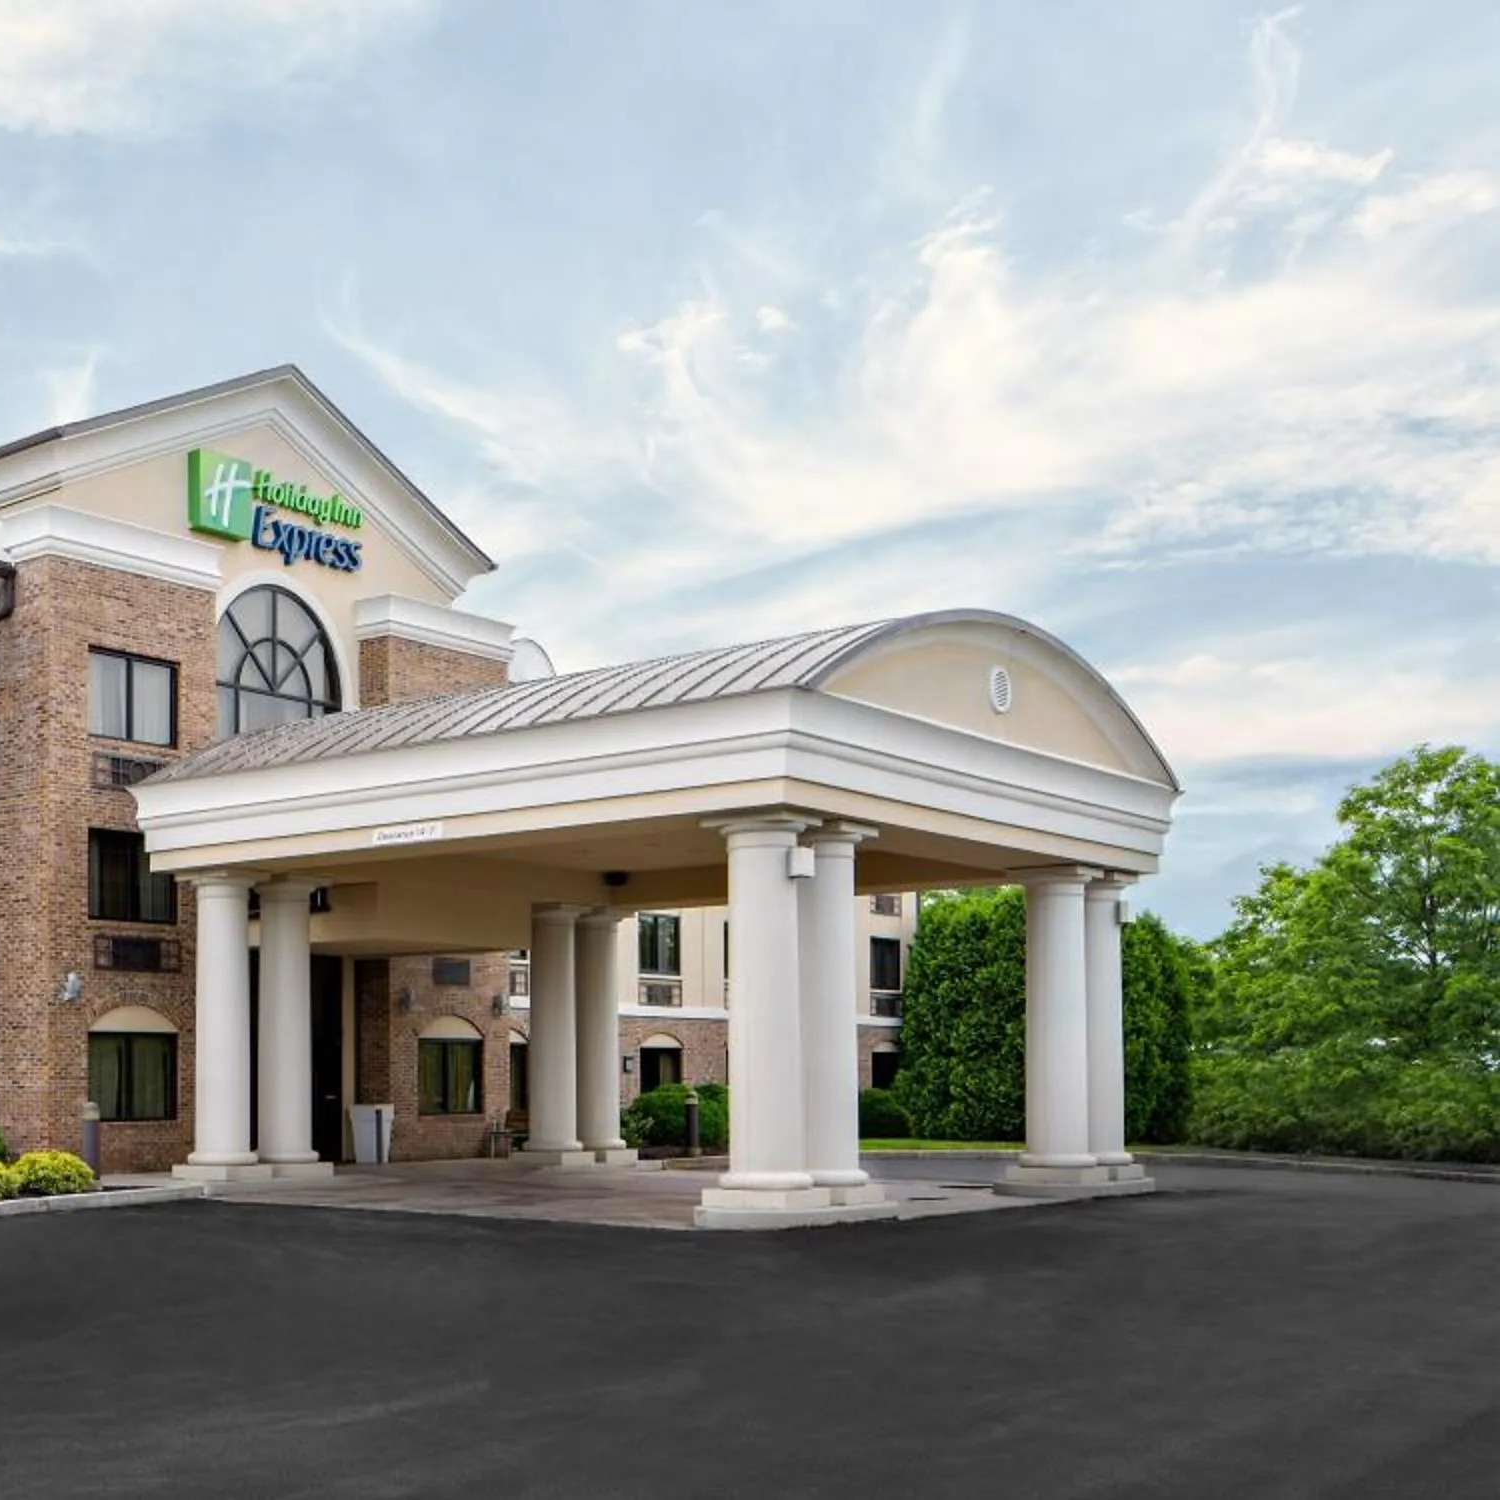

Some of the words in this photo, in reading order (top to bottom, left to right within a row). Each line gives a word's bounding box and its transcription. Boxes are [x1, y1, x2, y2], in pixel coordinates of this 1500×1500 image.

[204, 463, 252, 528] H
[253, 469, 332, 526] Holiday
[252, 505, 363, 574] Express
